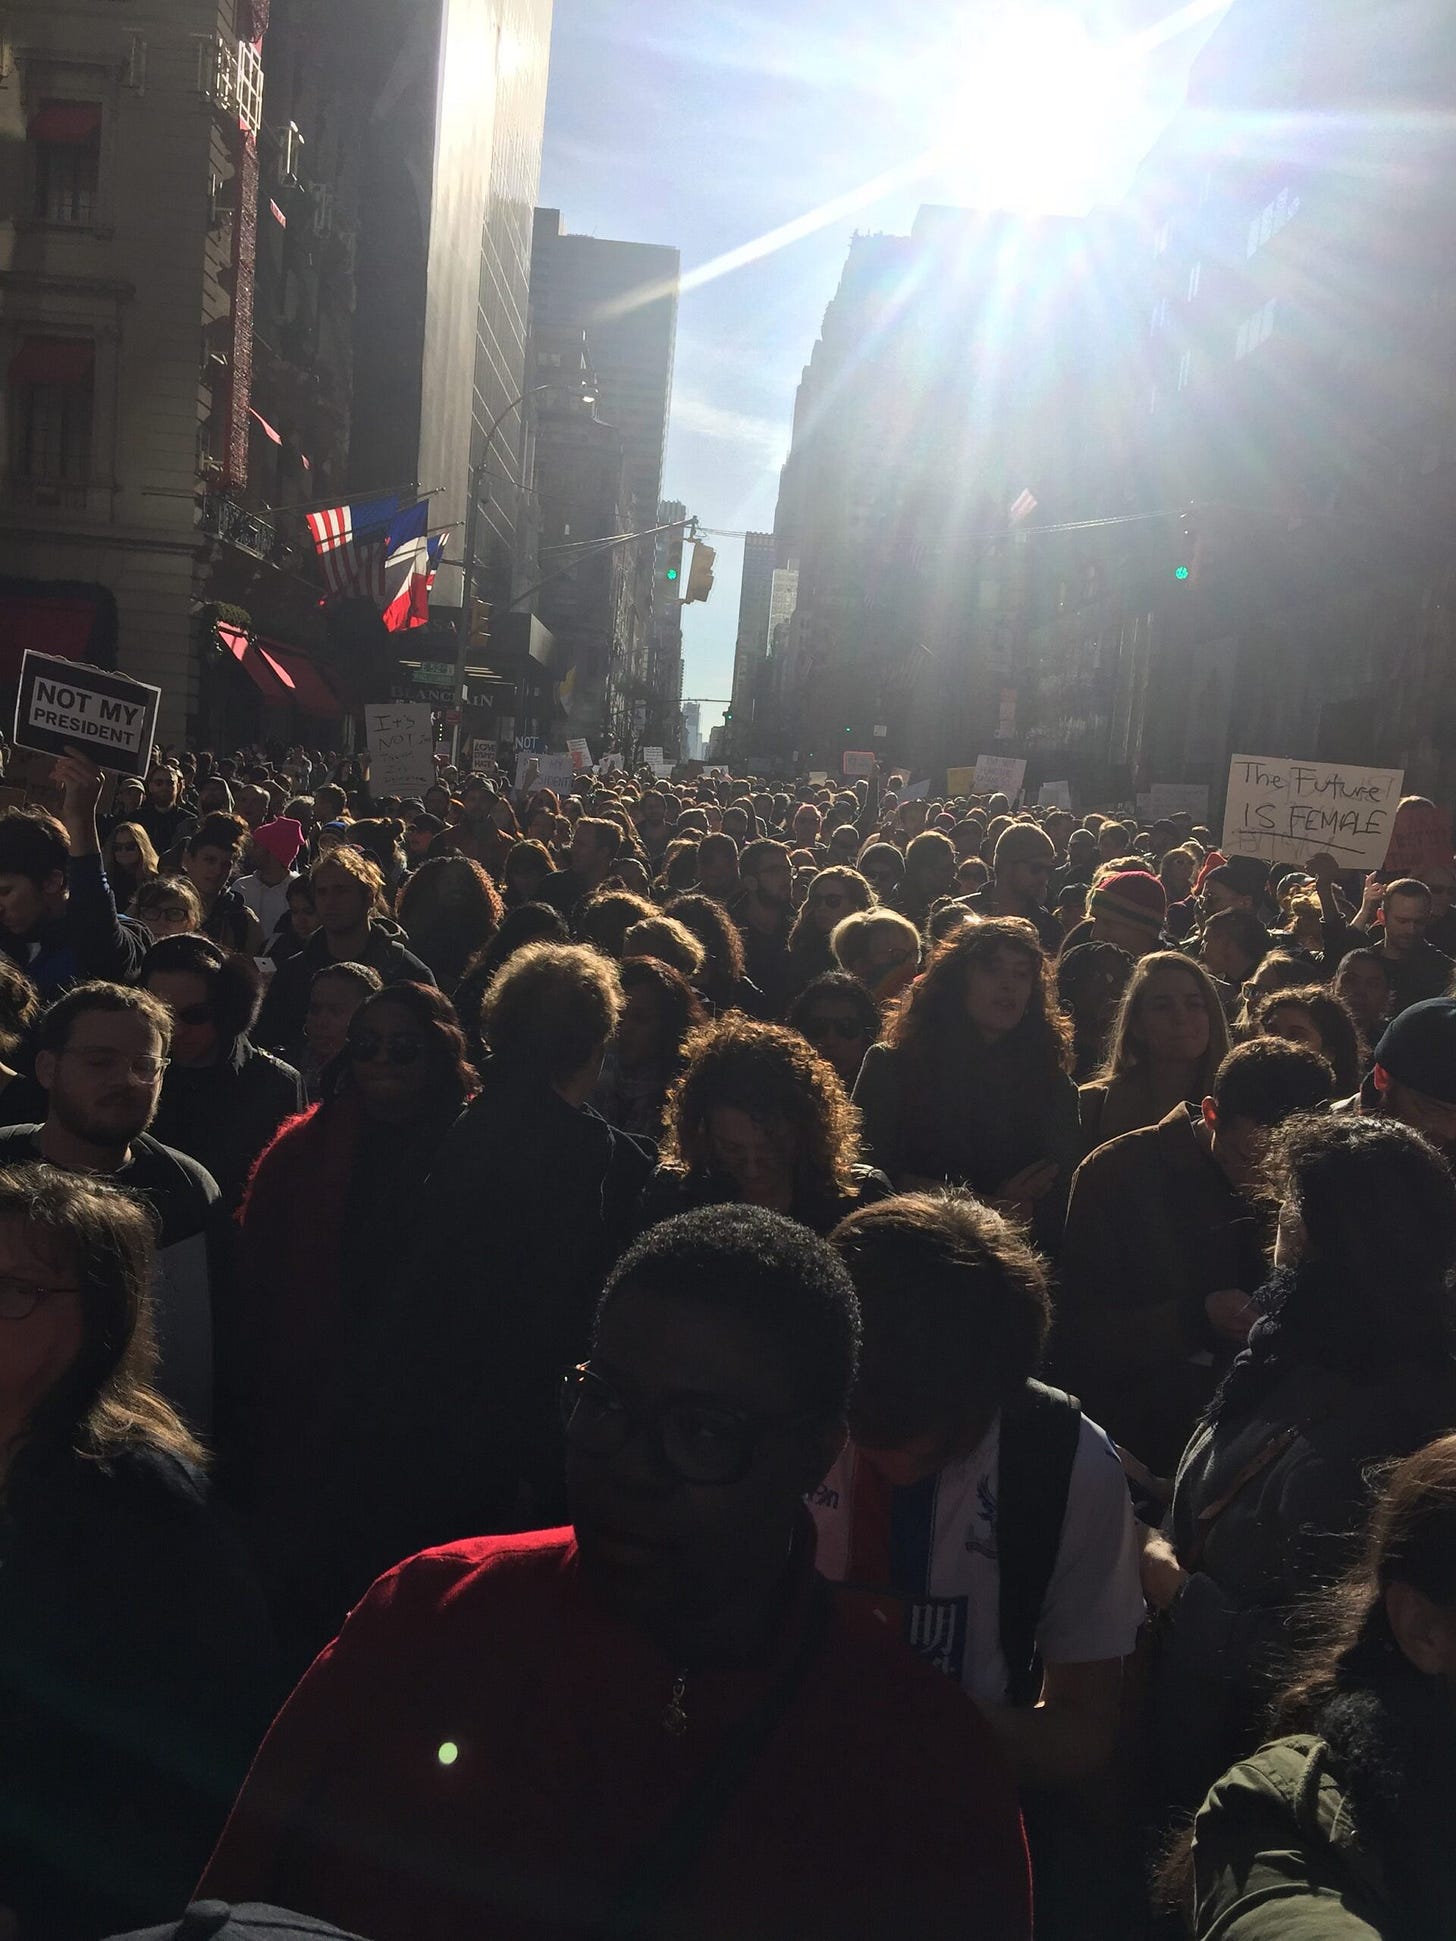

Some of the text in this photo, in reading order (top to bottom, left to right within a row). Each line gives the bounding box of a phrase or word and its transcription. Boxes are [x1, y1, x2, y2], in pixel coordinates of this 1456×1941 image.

[36, 681, 139, 726] NOT MY
[391, 685, 494, 708] BLANCIN
[33, 707, 135, 745] PRESIDENT
[378, 733, 412, 751] NOT
[514, 736, 539, 749] NOT
[1234, 761, 1381, 803] The Future
[1245, 803, 1387, 837] IS FEMALE
